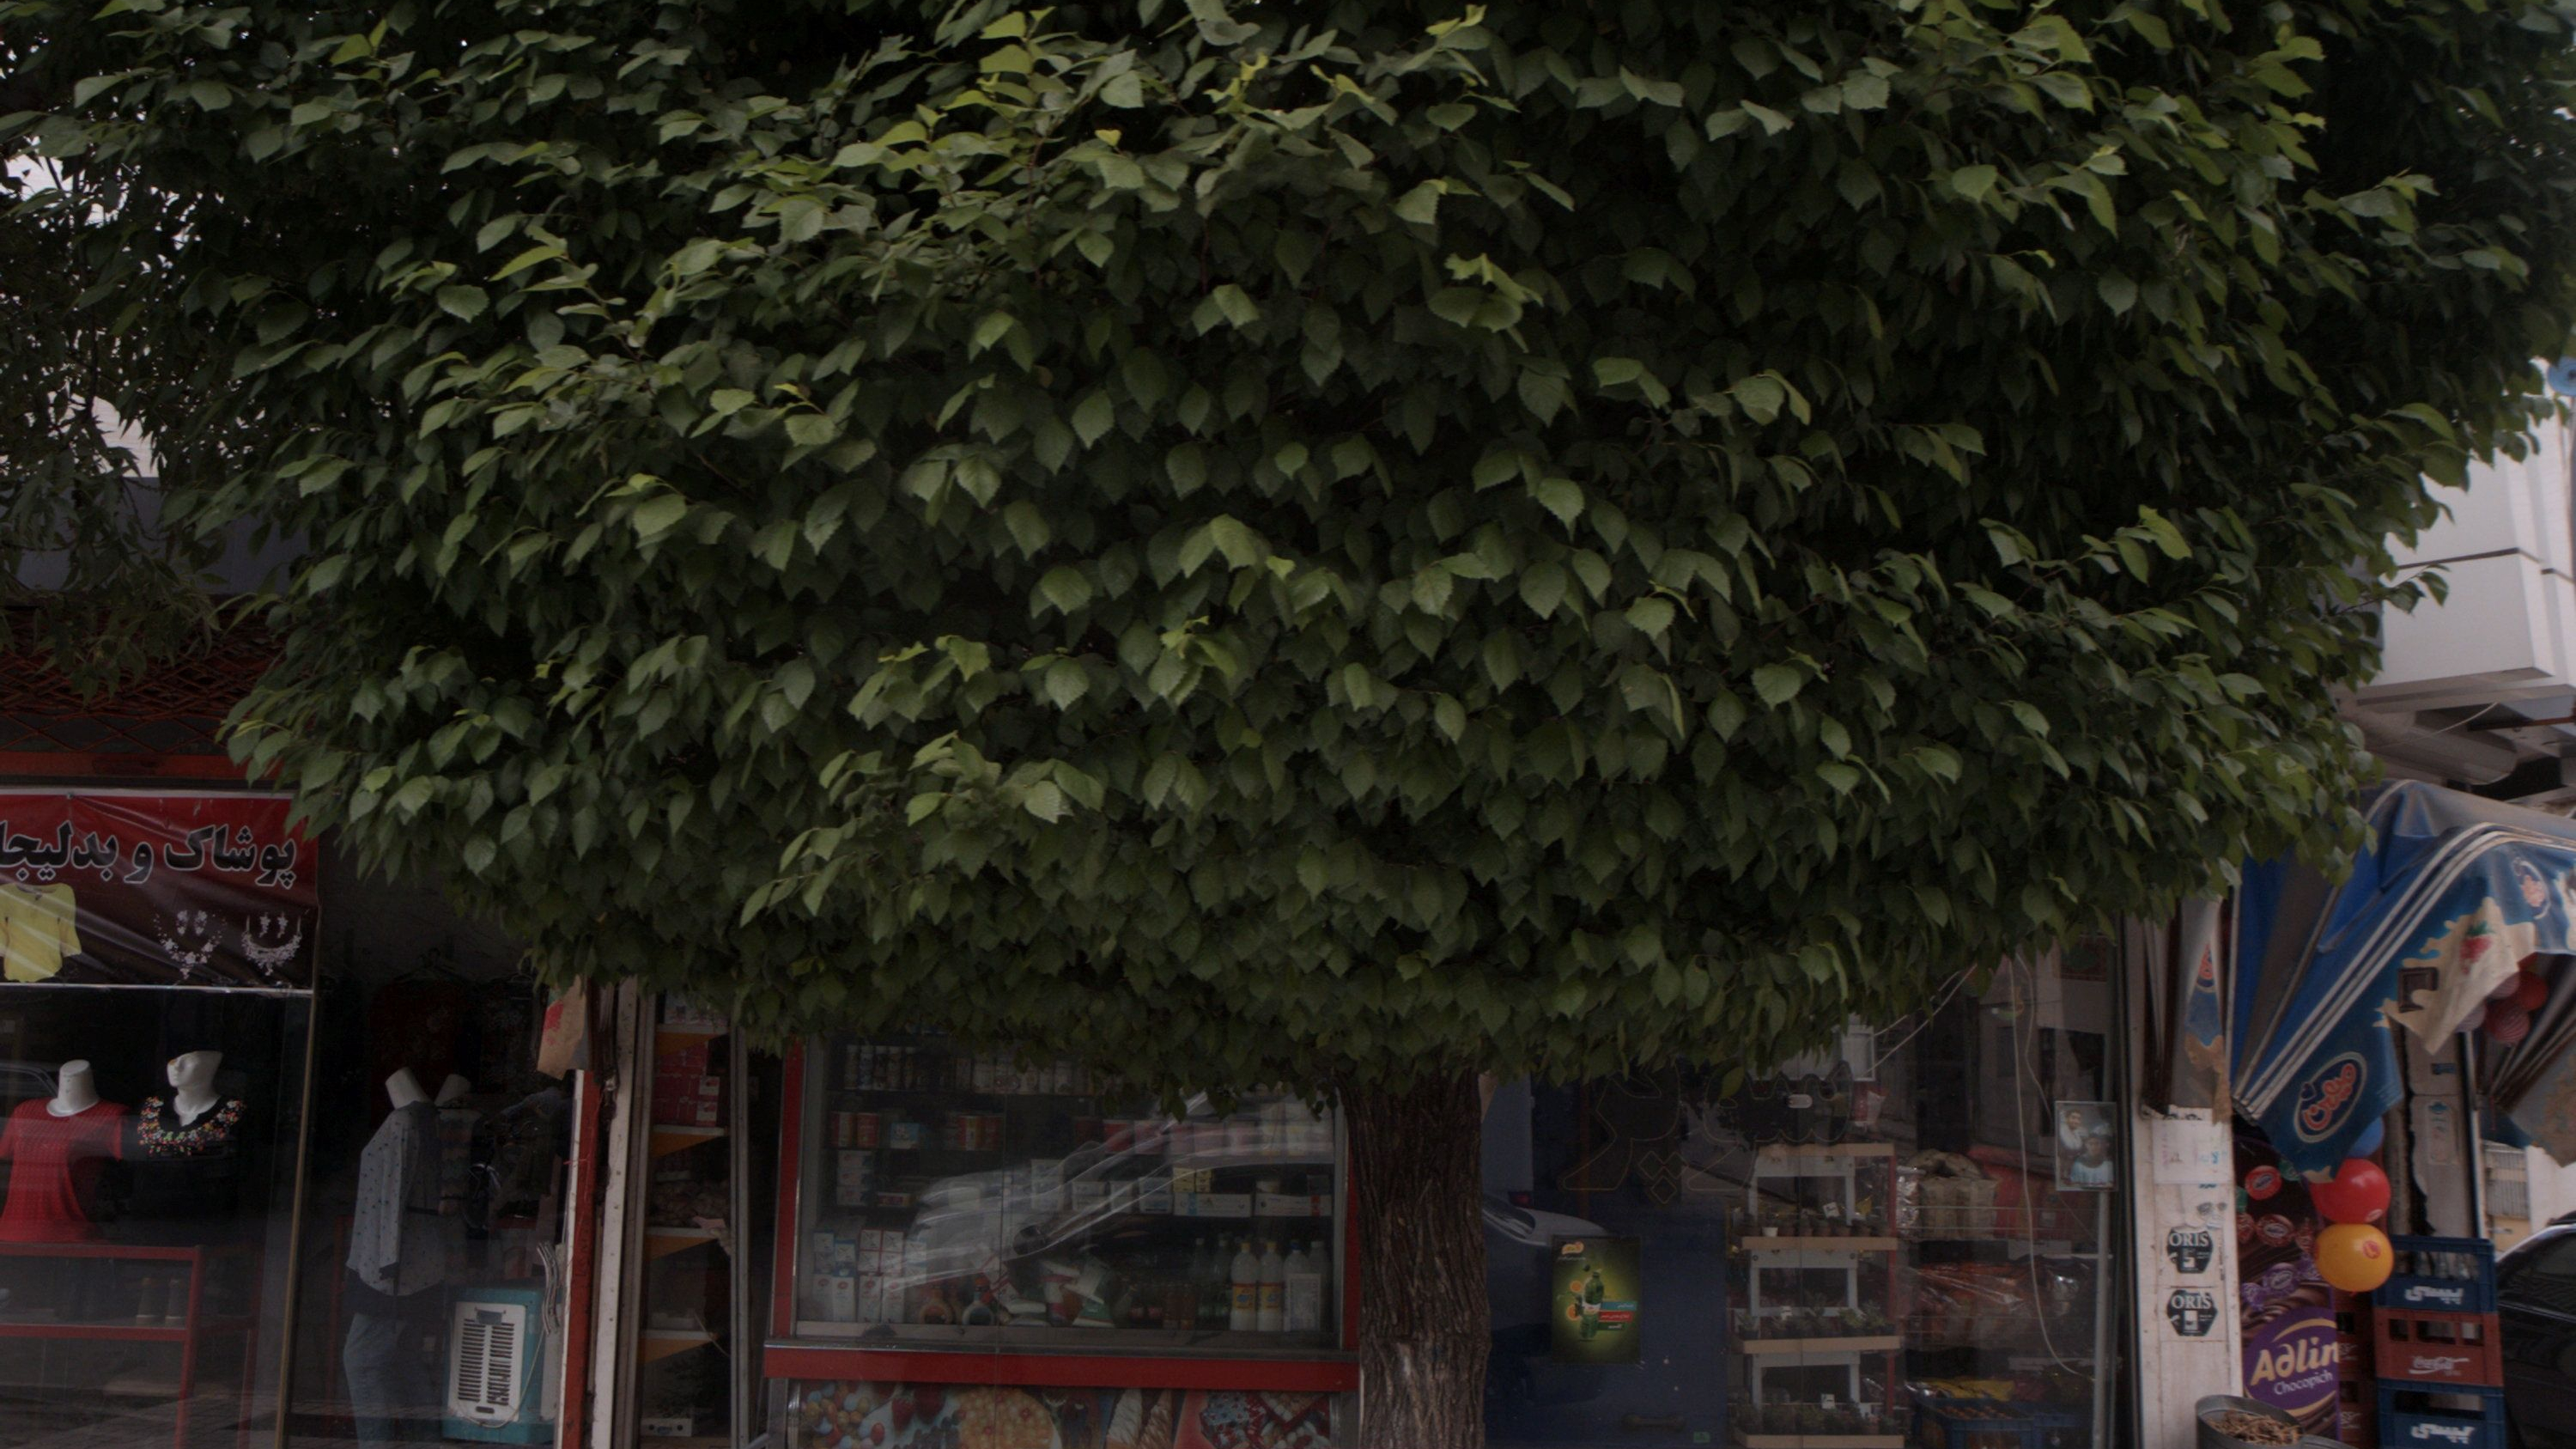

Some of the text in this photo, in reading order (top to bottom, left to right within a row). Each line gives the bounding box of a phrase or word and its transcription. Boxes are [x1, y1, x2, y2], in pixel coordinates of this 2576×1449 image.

[0, 819, 297, 890] پوشاک و بدلیجا
[2168, 1232, 2210, 1247] ORIS
[2170, 1294, 2213, 1310] ORIS
[2250, 1336, 2340, 1386] Adlin
